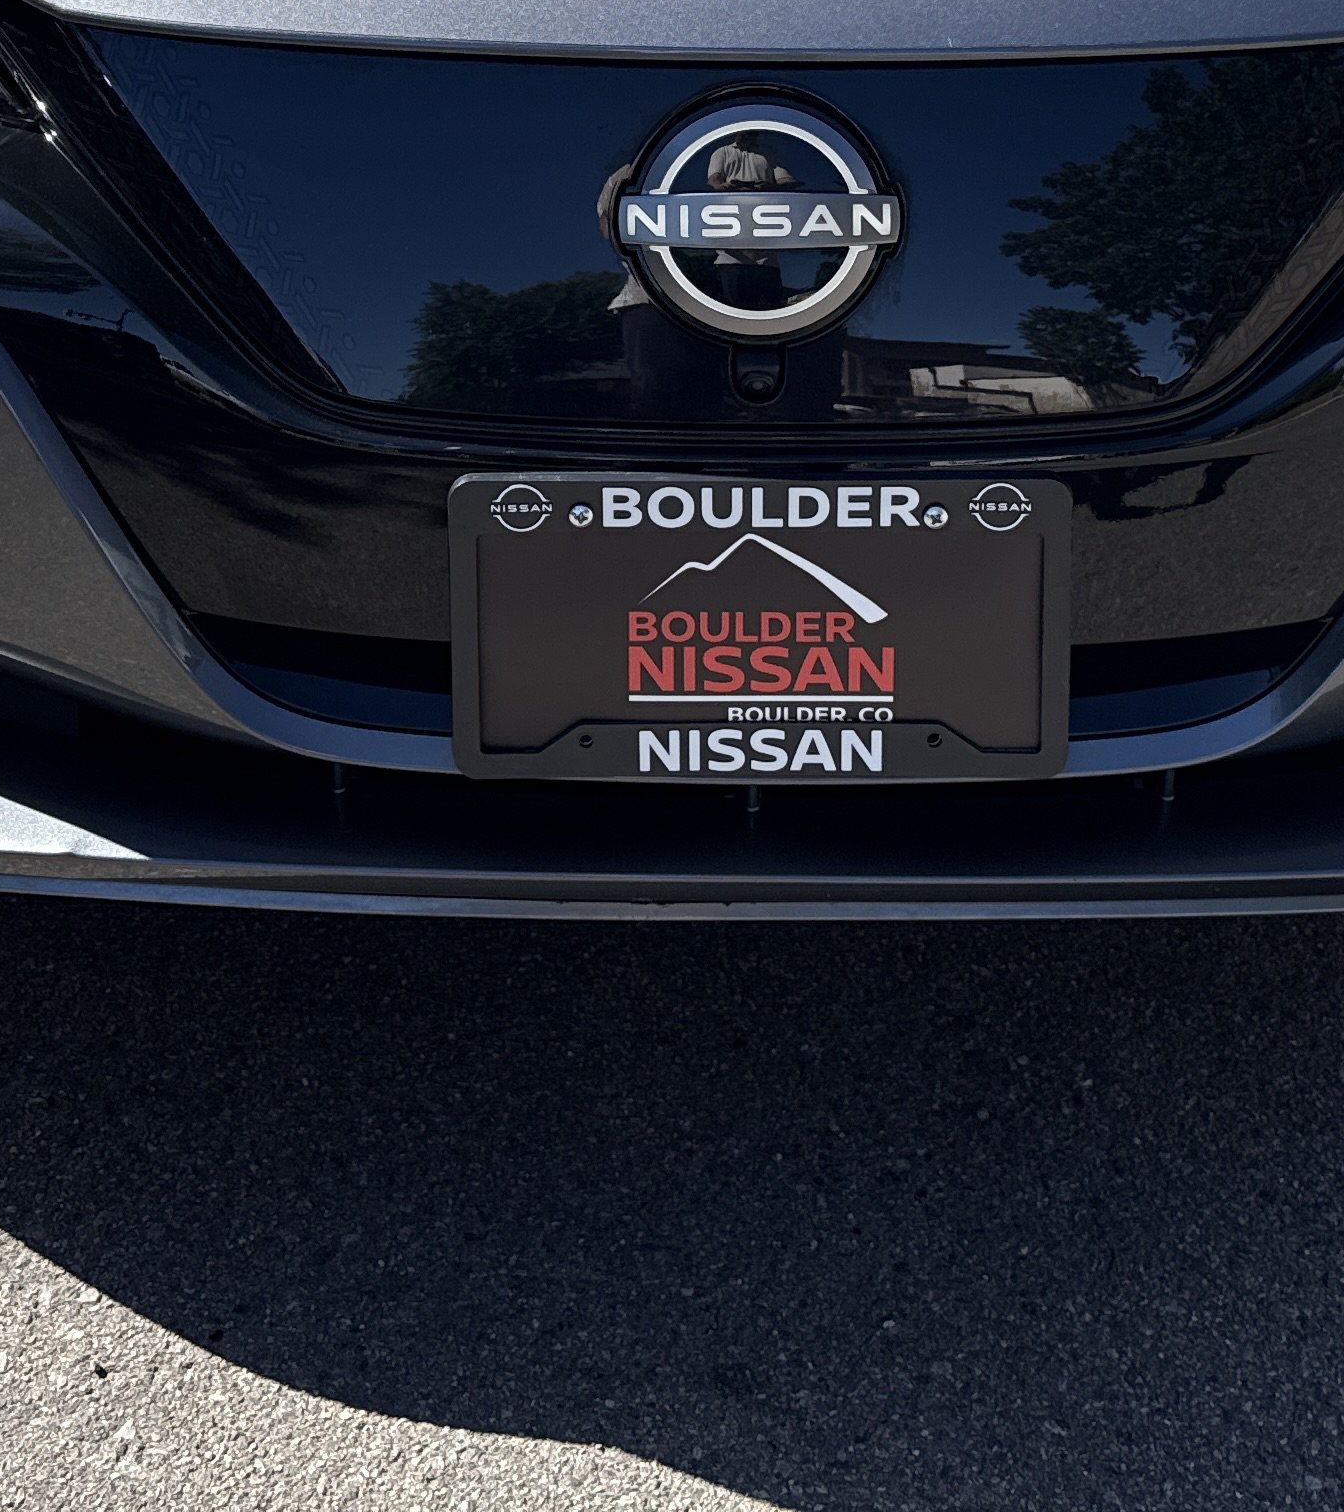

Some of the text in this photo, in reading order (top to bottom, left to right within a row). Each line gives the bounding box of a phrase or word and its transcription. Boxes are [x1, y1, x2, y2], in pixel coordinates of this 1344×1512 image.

[626, 203, 892, 238] NISSAN
[490, 503, 553, 513] NISSAN
[602, 486, 921, 529] BOULDER
[968, 502, 1032, 512] NISSAN
[628, 610, 856, 643] BOULDER
[628, 646, 895, 692] NISSAN
[858, 707, 894, 722] CO
[638, 728, 884, 773] NISSAN
